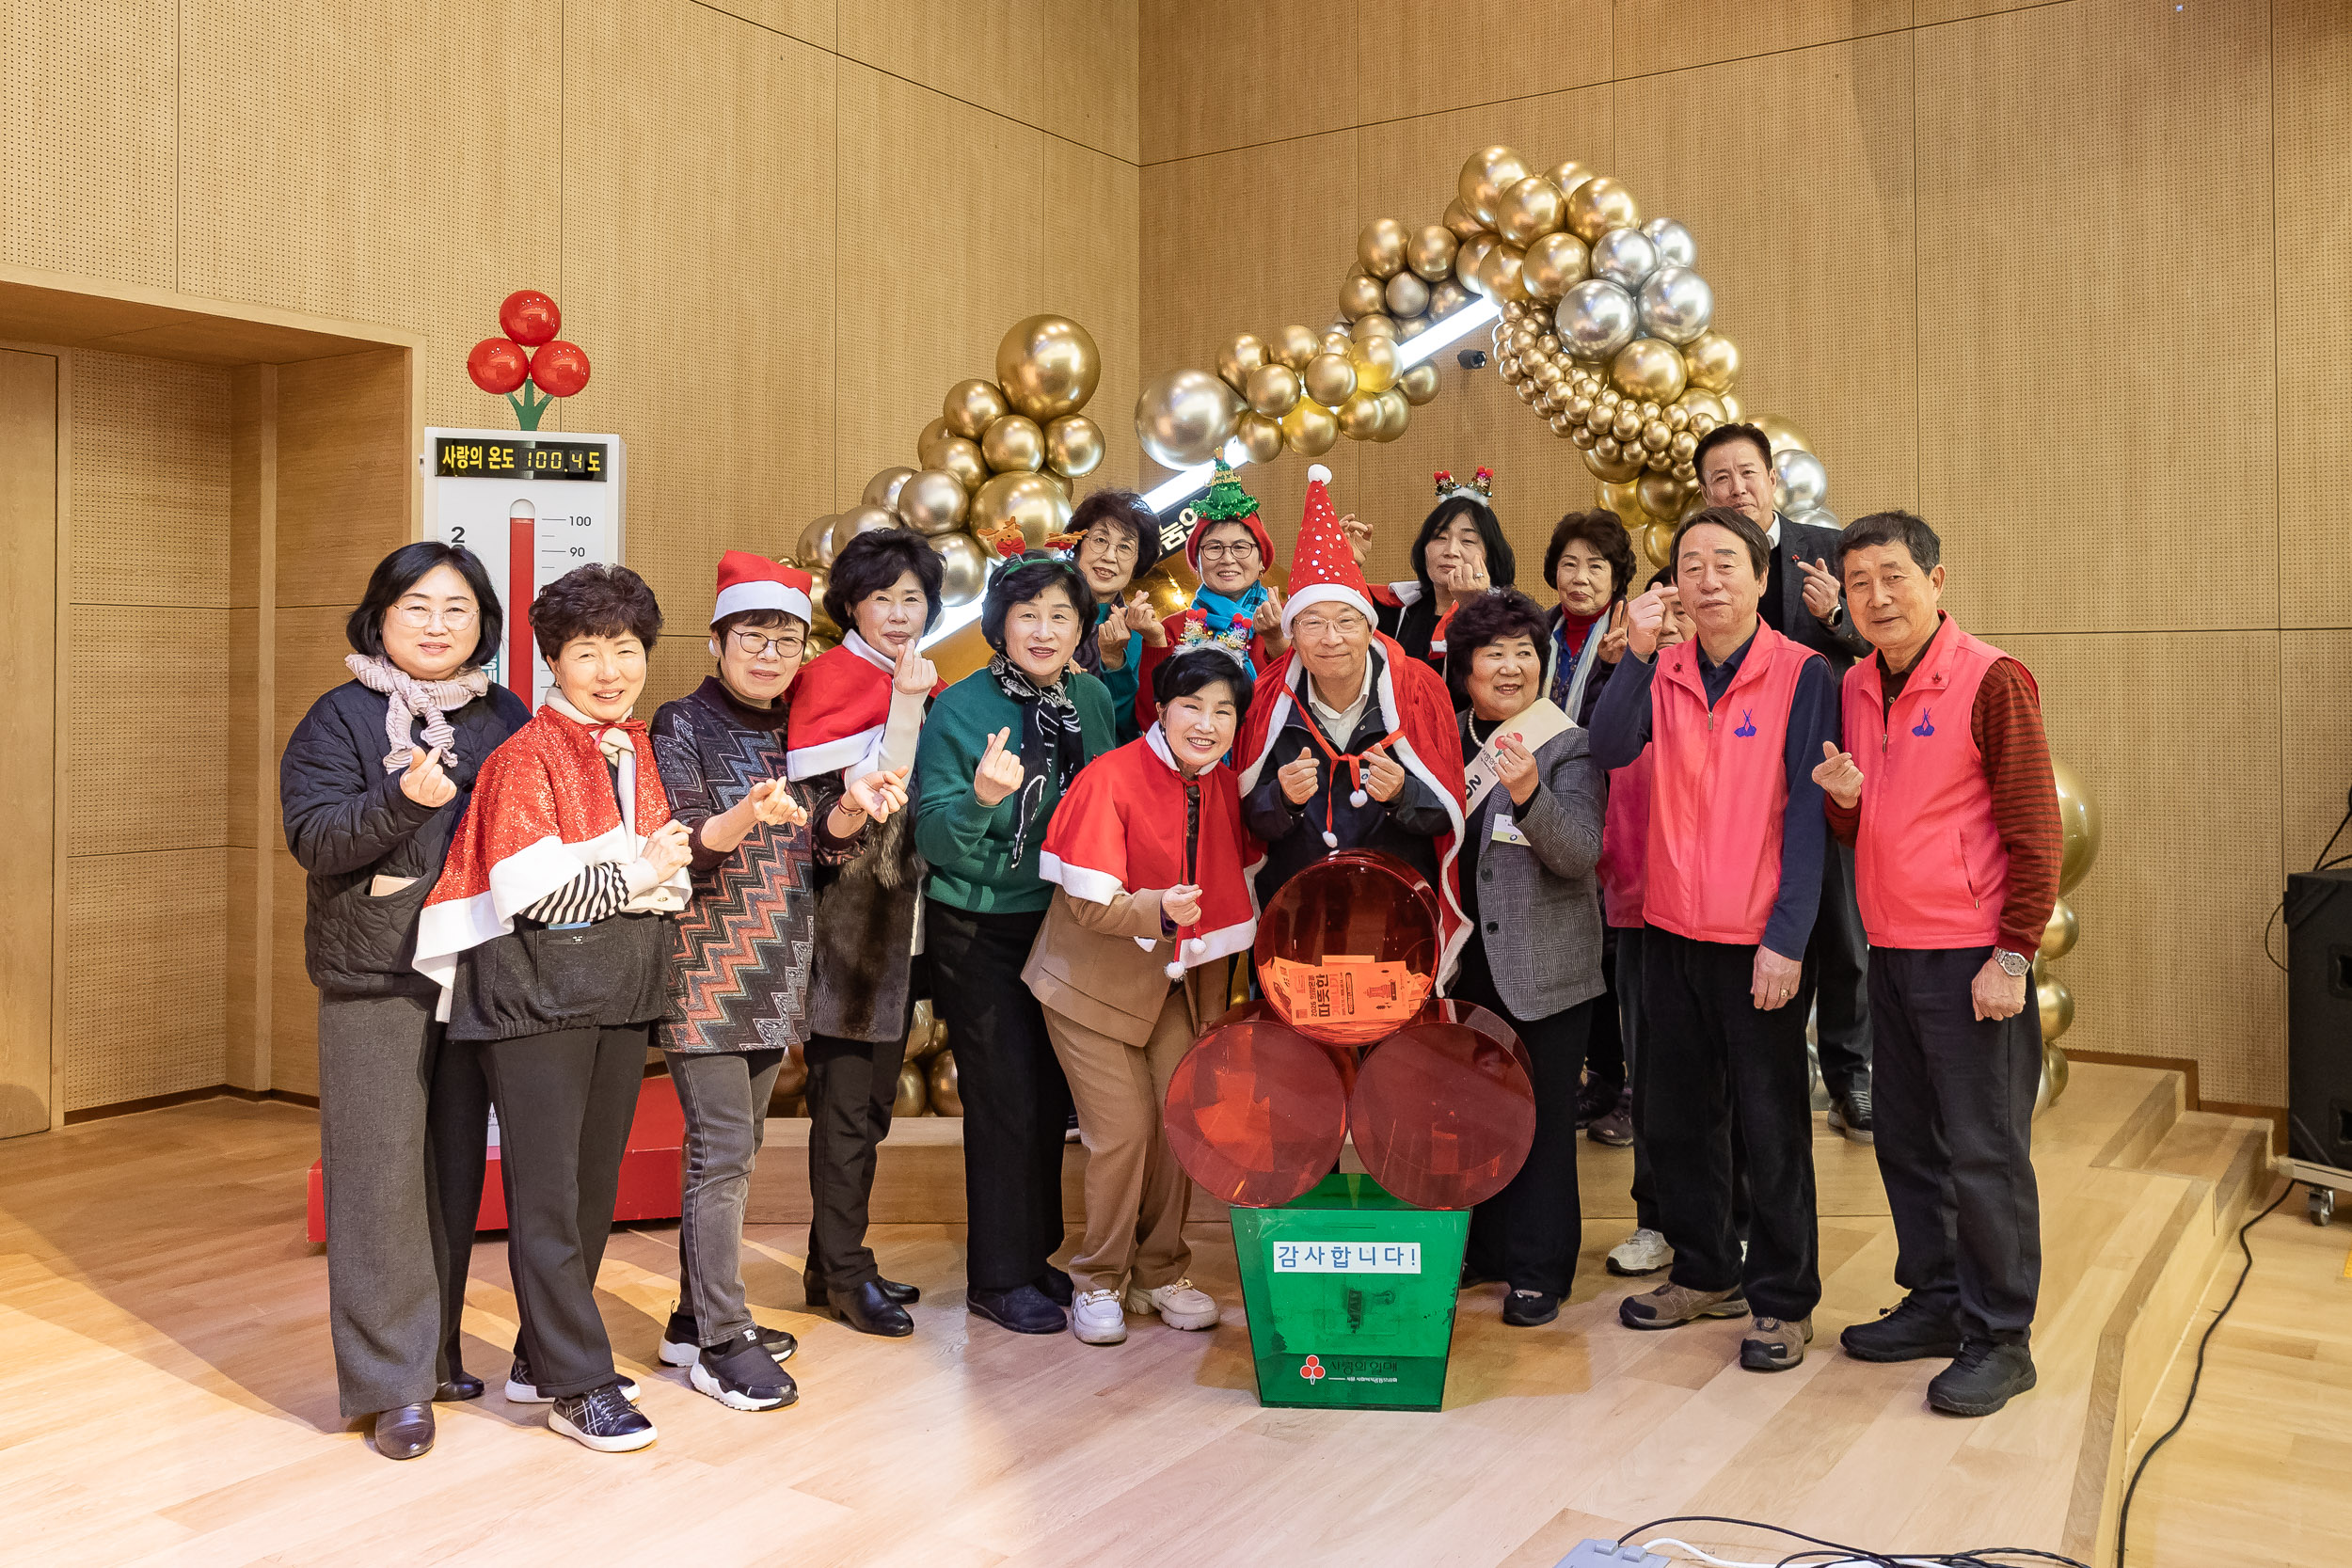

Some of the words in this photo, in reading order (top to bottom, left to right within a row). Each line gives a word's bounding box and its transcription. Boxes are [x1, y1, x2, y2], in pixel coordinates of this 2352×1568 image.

[441, 445, 483, 469] 사랑의
[487, 446, 515, 470] 온도
[569, 515, 592, 527] 100
[569, 546, 585, 558] 90
[1315, 974, 1330, 1018] 따뜻한
[1277, 1245, 1416, 1269] 감사합니다!
